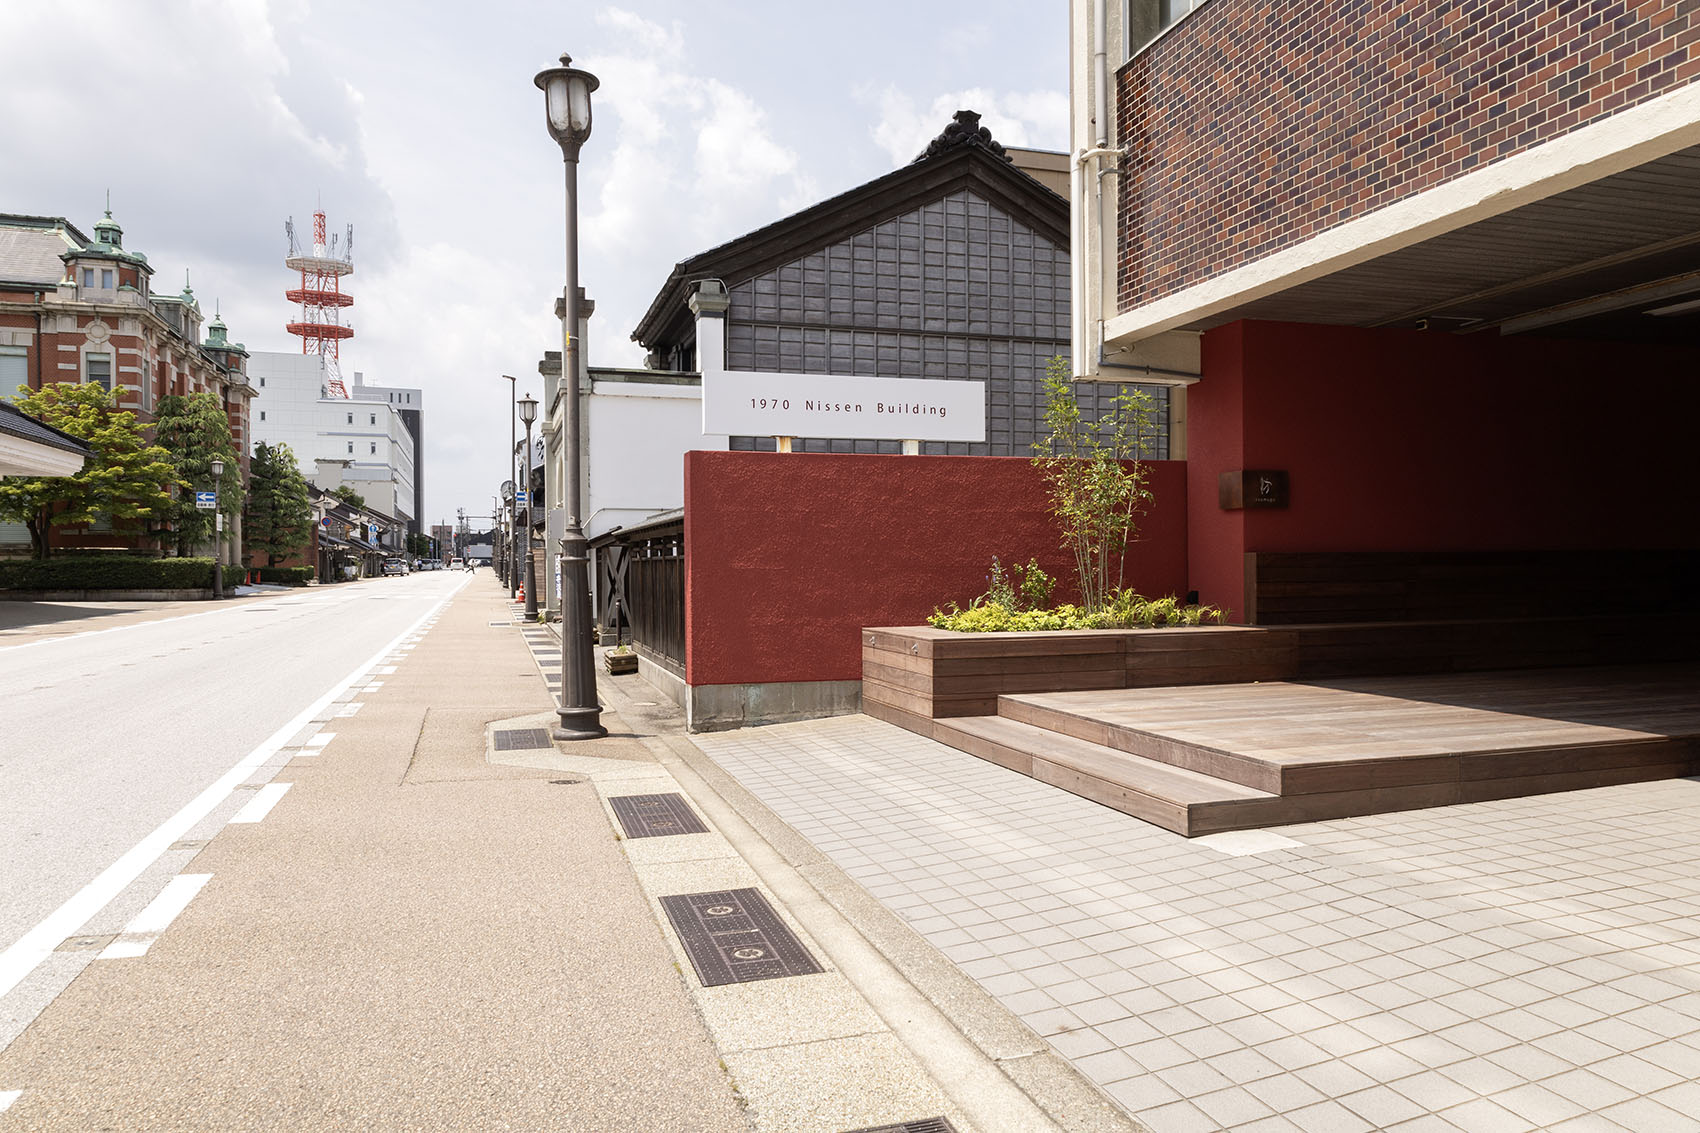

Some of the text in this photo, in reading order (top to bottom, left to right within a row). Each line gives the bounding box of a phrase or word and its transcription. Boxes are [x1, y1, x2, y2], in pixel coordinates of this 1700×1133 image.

[750, 398, 946, 418] 1970 Nissen Building
